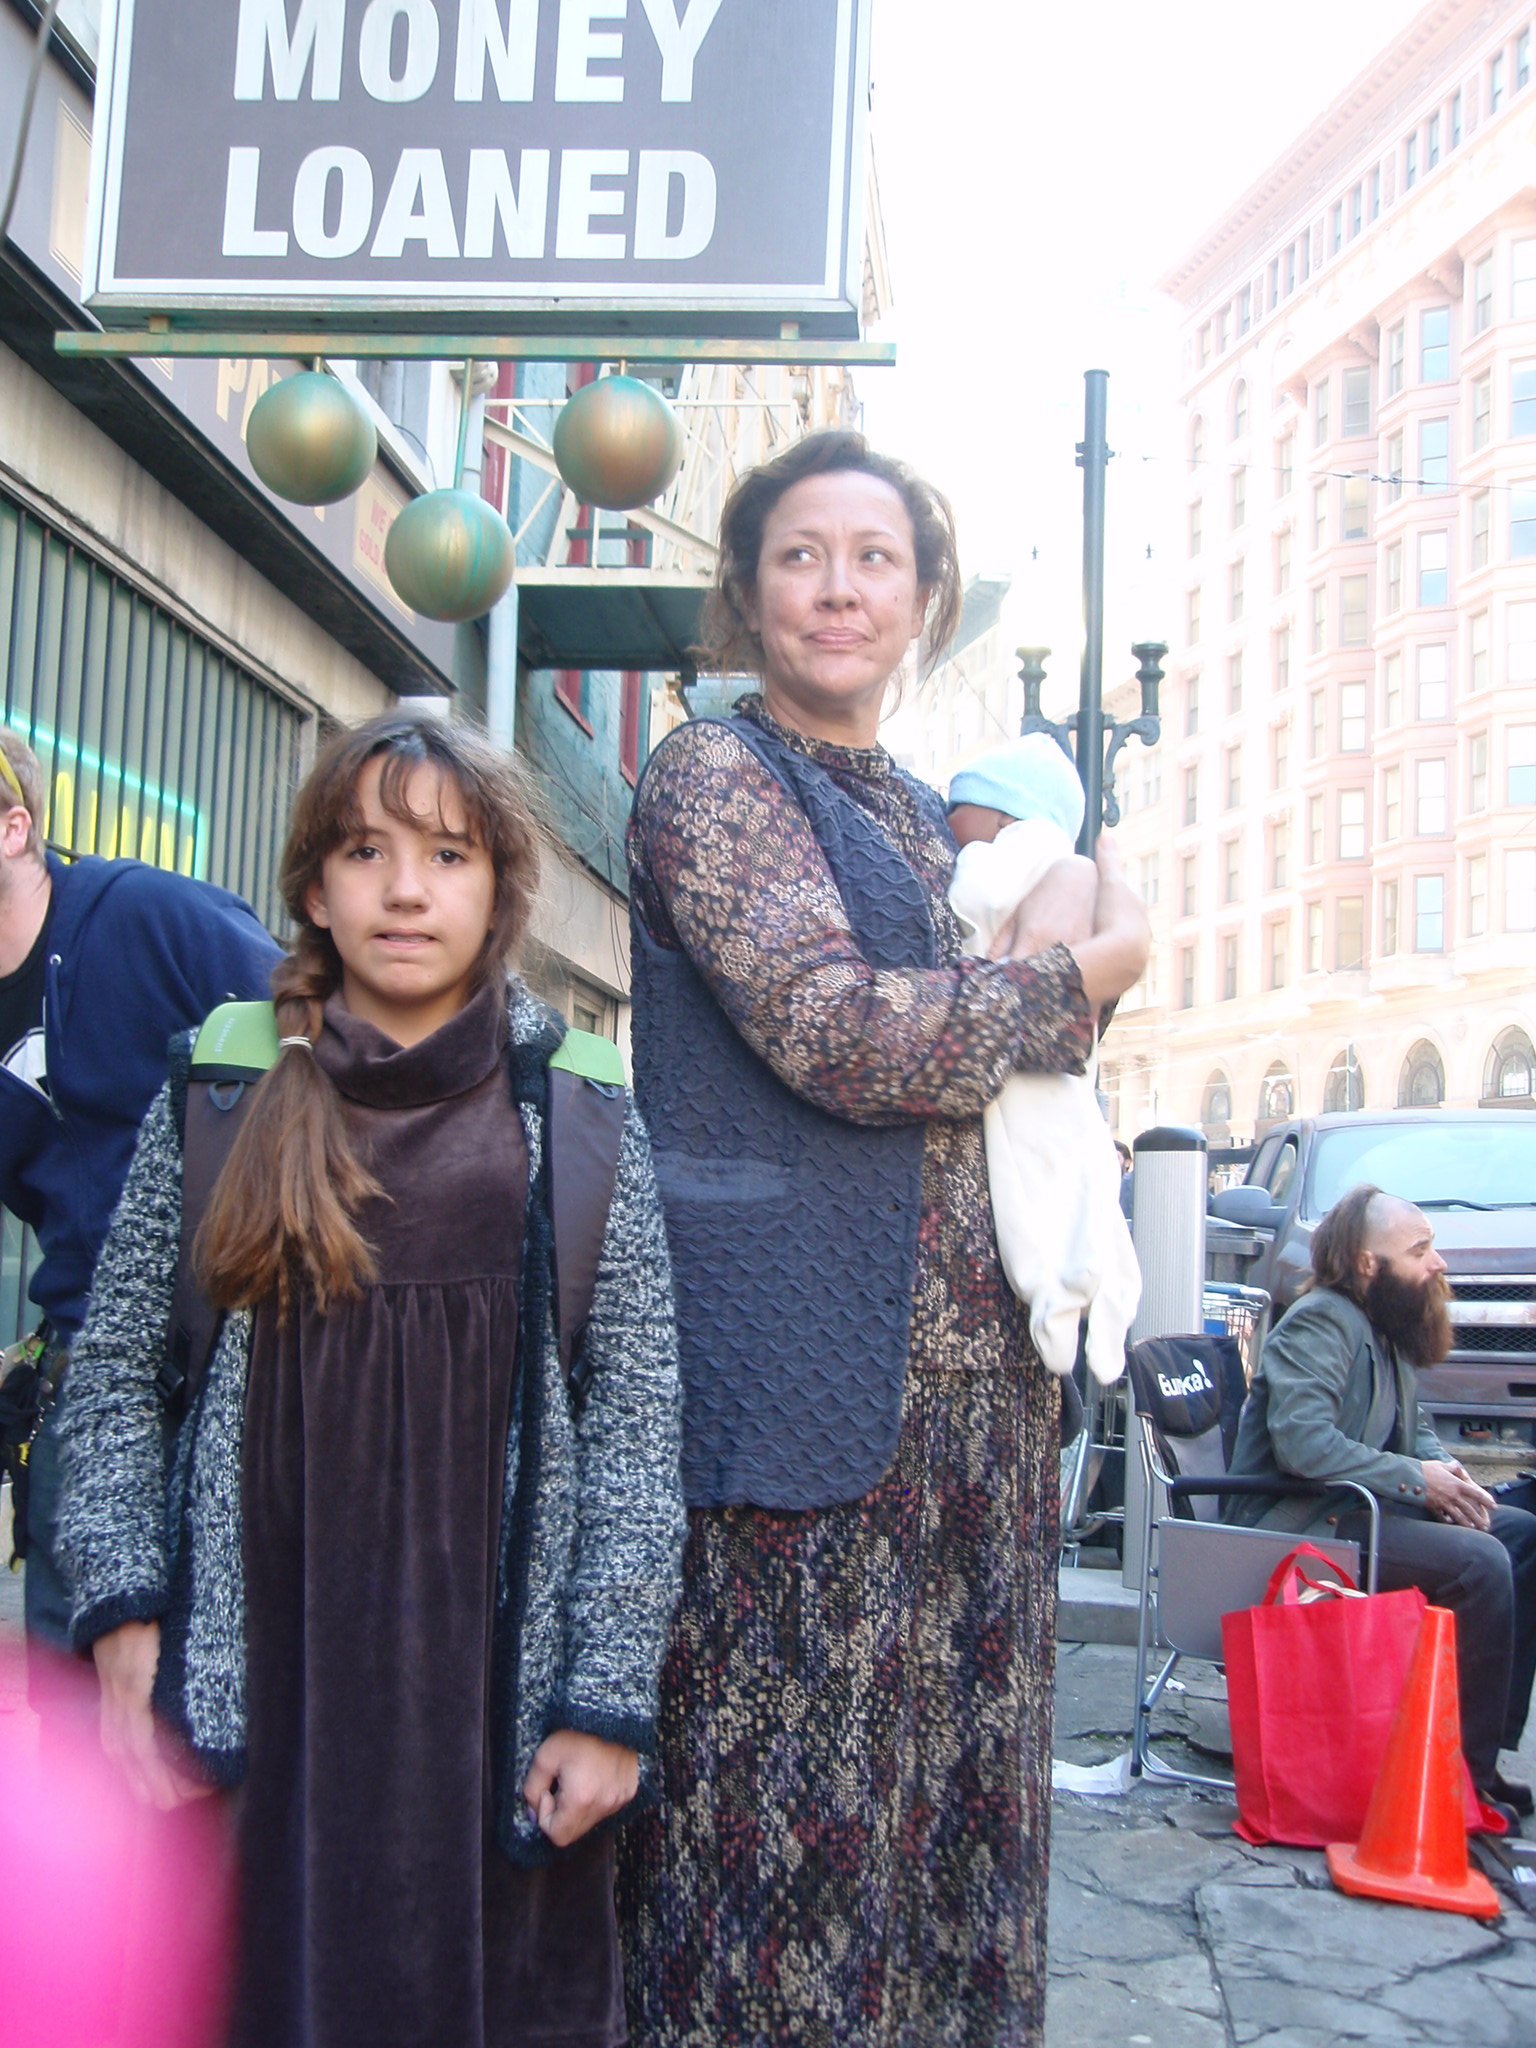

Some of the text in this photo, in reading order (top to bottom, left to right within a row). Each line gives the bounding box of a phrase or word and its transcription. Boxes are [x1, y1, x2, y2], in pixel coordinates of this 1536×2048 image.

[233, 0, 721, 102] MONEY
[222, 146, 717, 259] LOANED
[1158, 1359, 1214, 1397] Euka!
